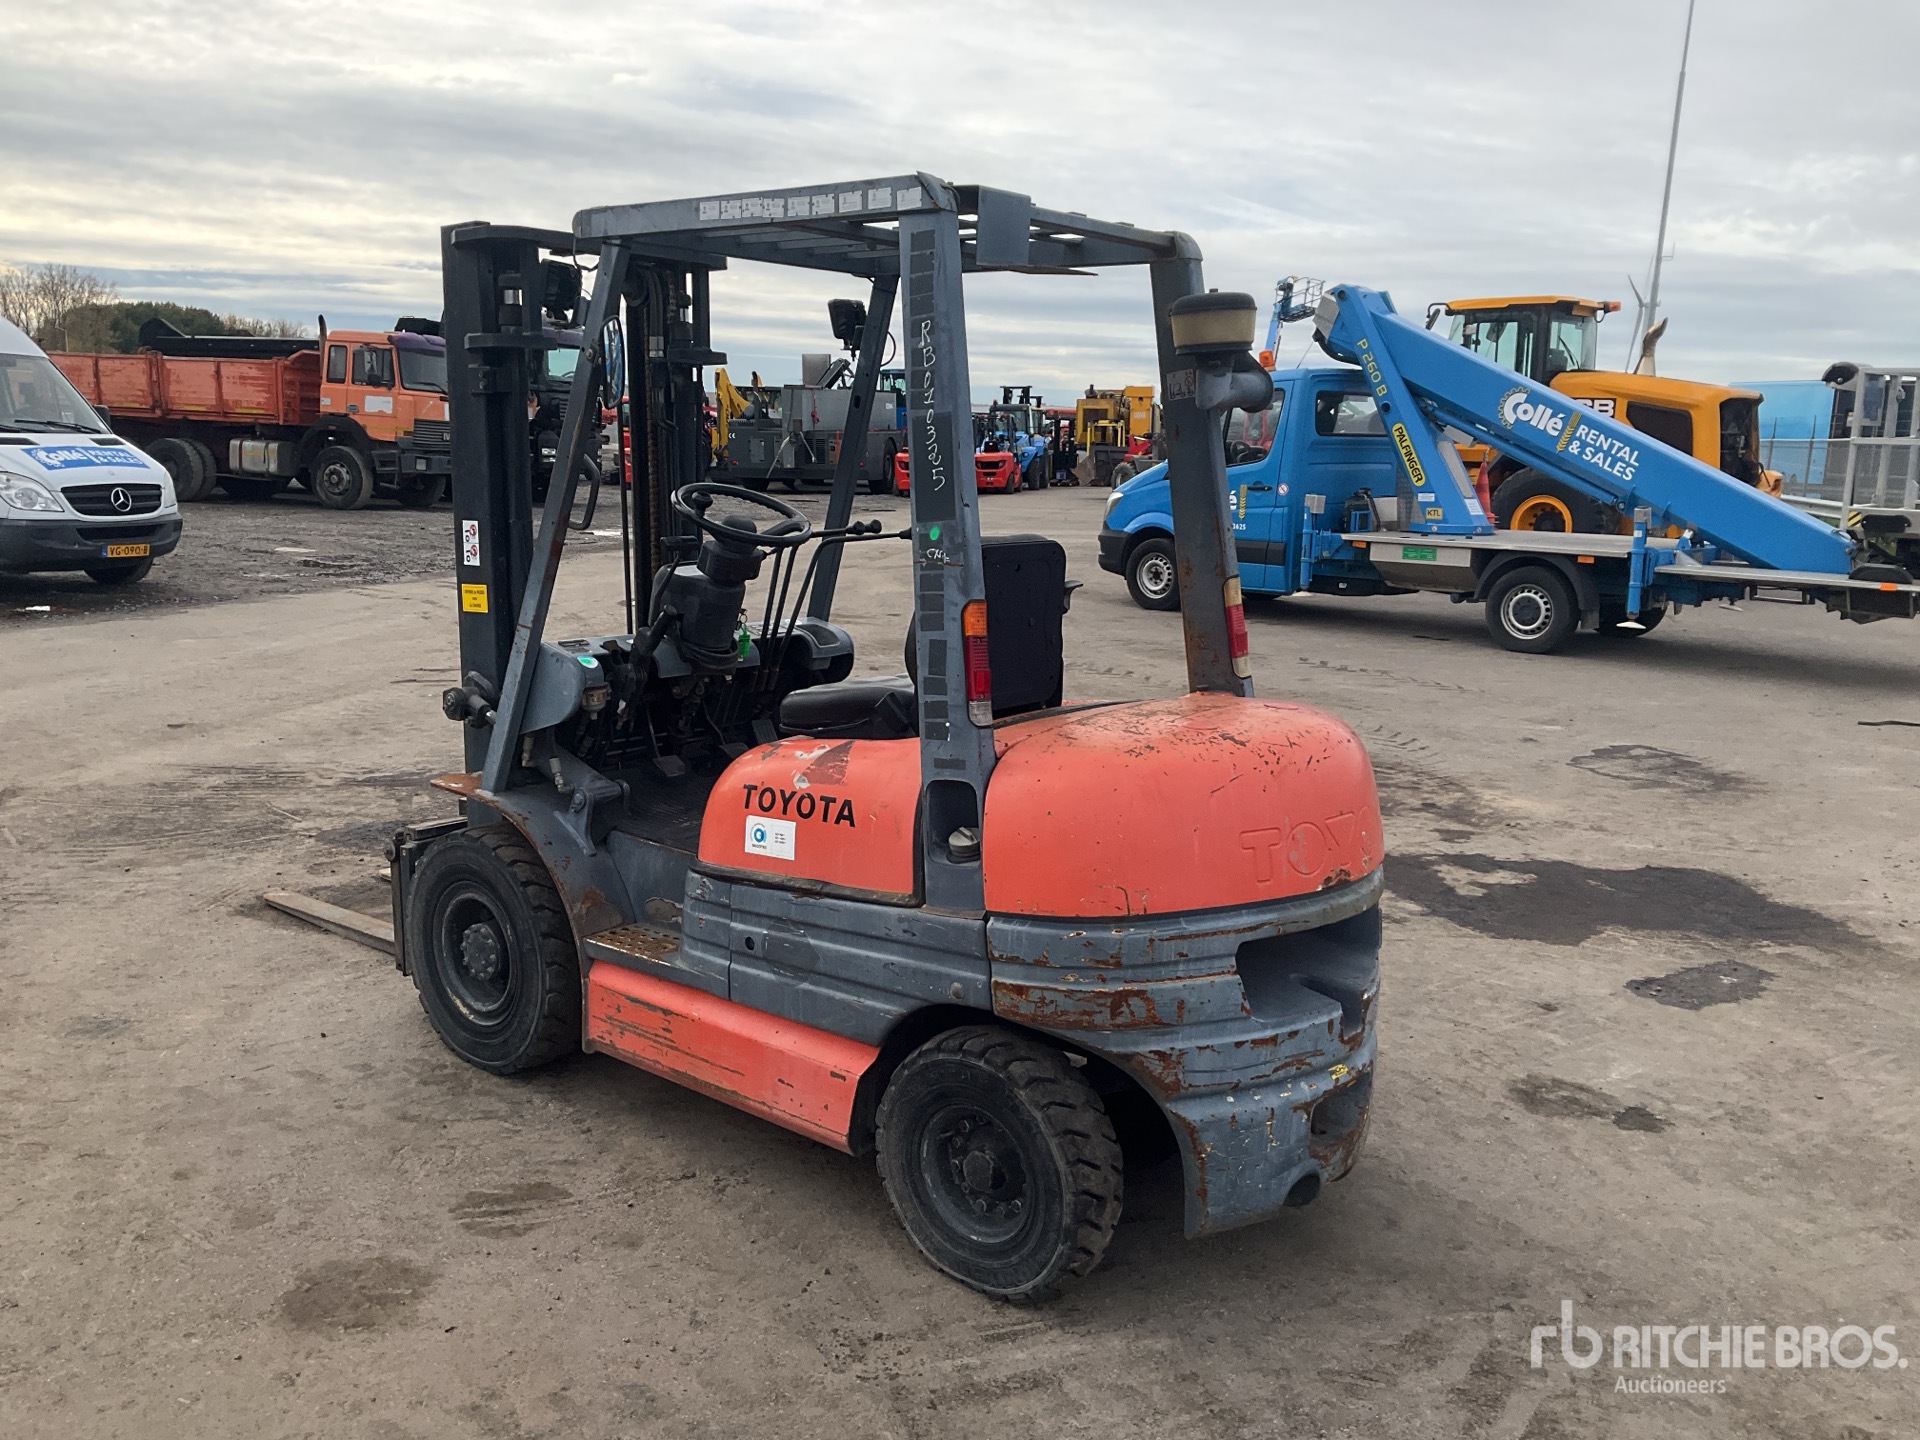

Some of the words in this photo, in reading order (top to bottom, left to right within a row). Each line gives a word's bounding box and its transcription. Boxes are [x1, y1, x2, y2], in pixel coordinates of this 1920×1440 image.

[1356, 338, 1369, 350] P
[1361, 350, 1382, 383] 260
[1375, 384, 1388, 397] B
[1503, 391, 1567, 437] Collé
[1394, 426, 1424, 484] PALFINGER
[1568, 439, 1581, 455] &
[1582, 446, 1636, 481] SALES
[1575, 424, 1640, 467] RENTAL
[1427, 509, 1441, 517] KTL
[743, 783, 856, 828] TOYOTA
